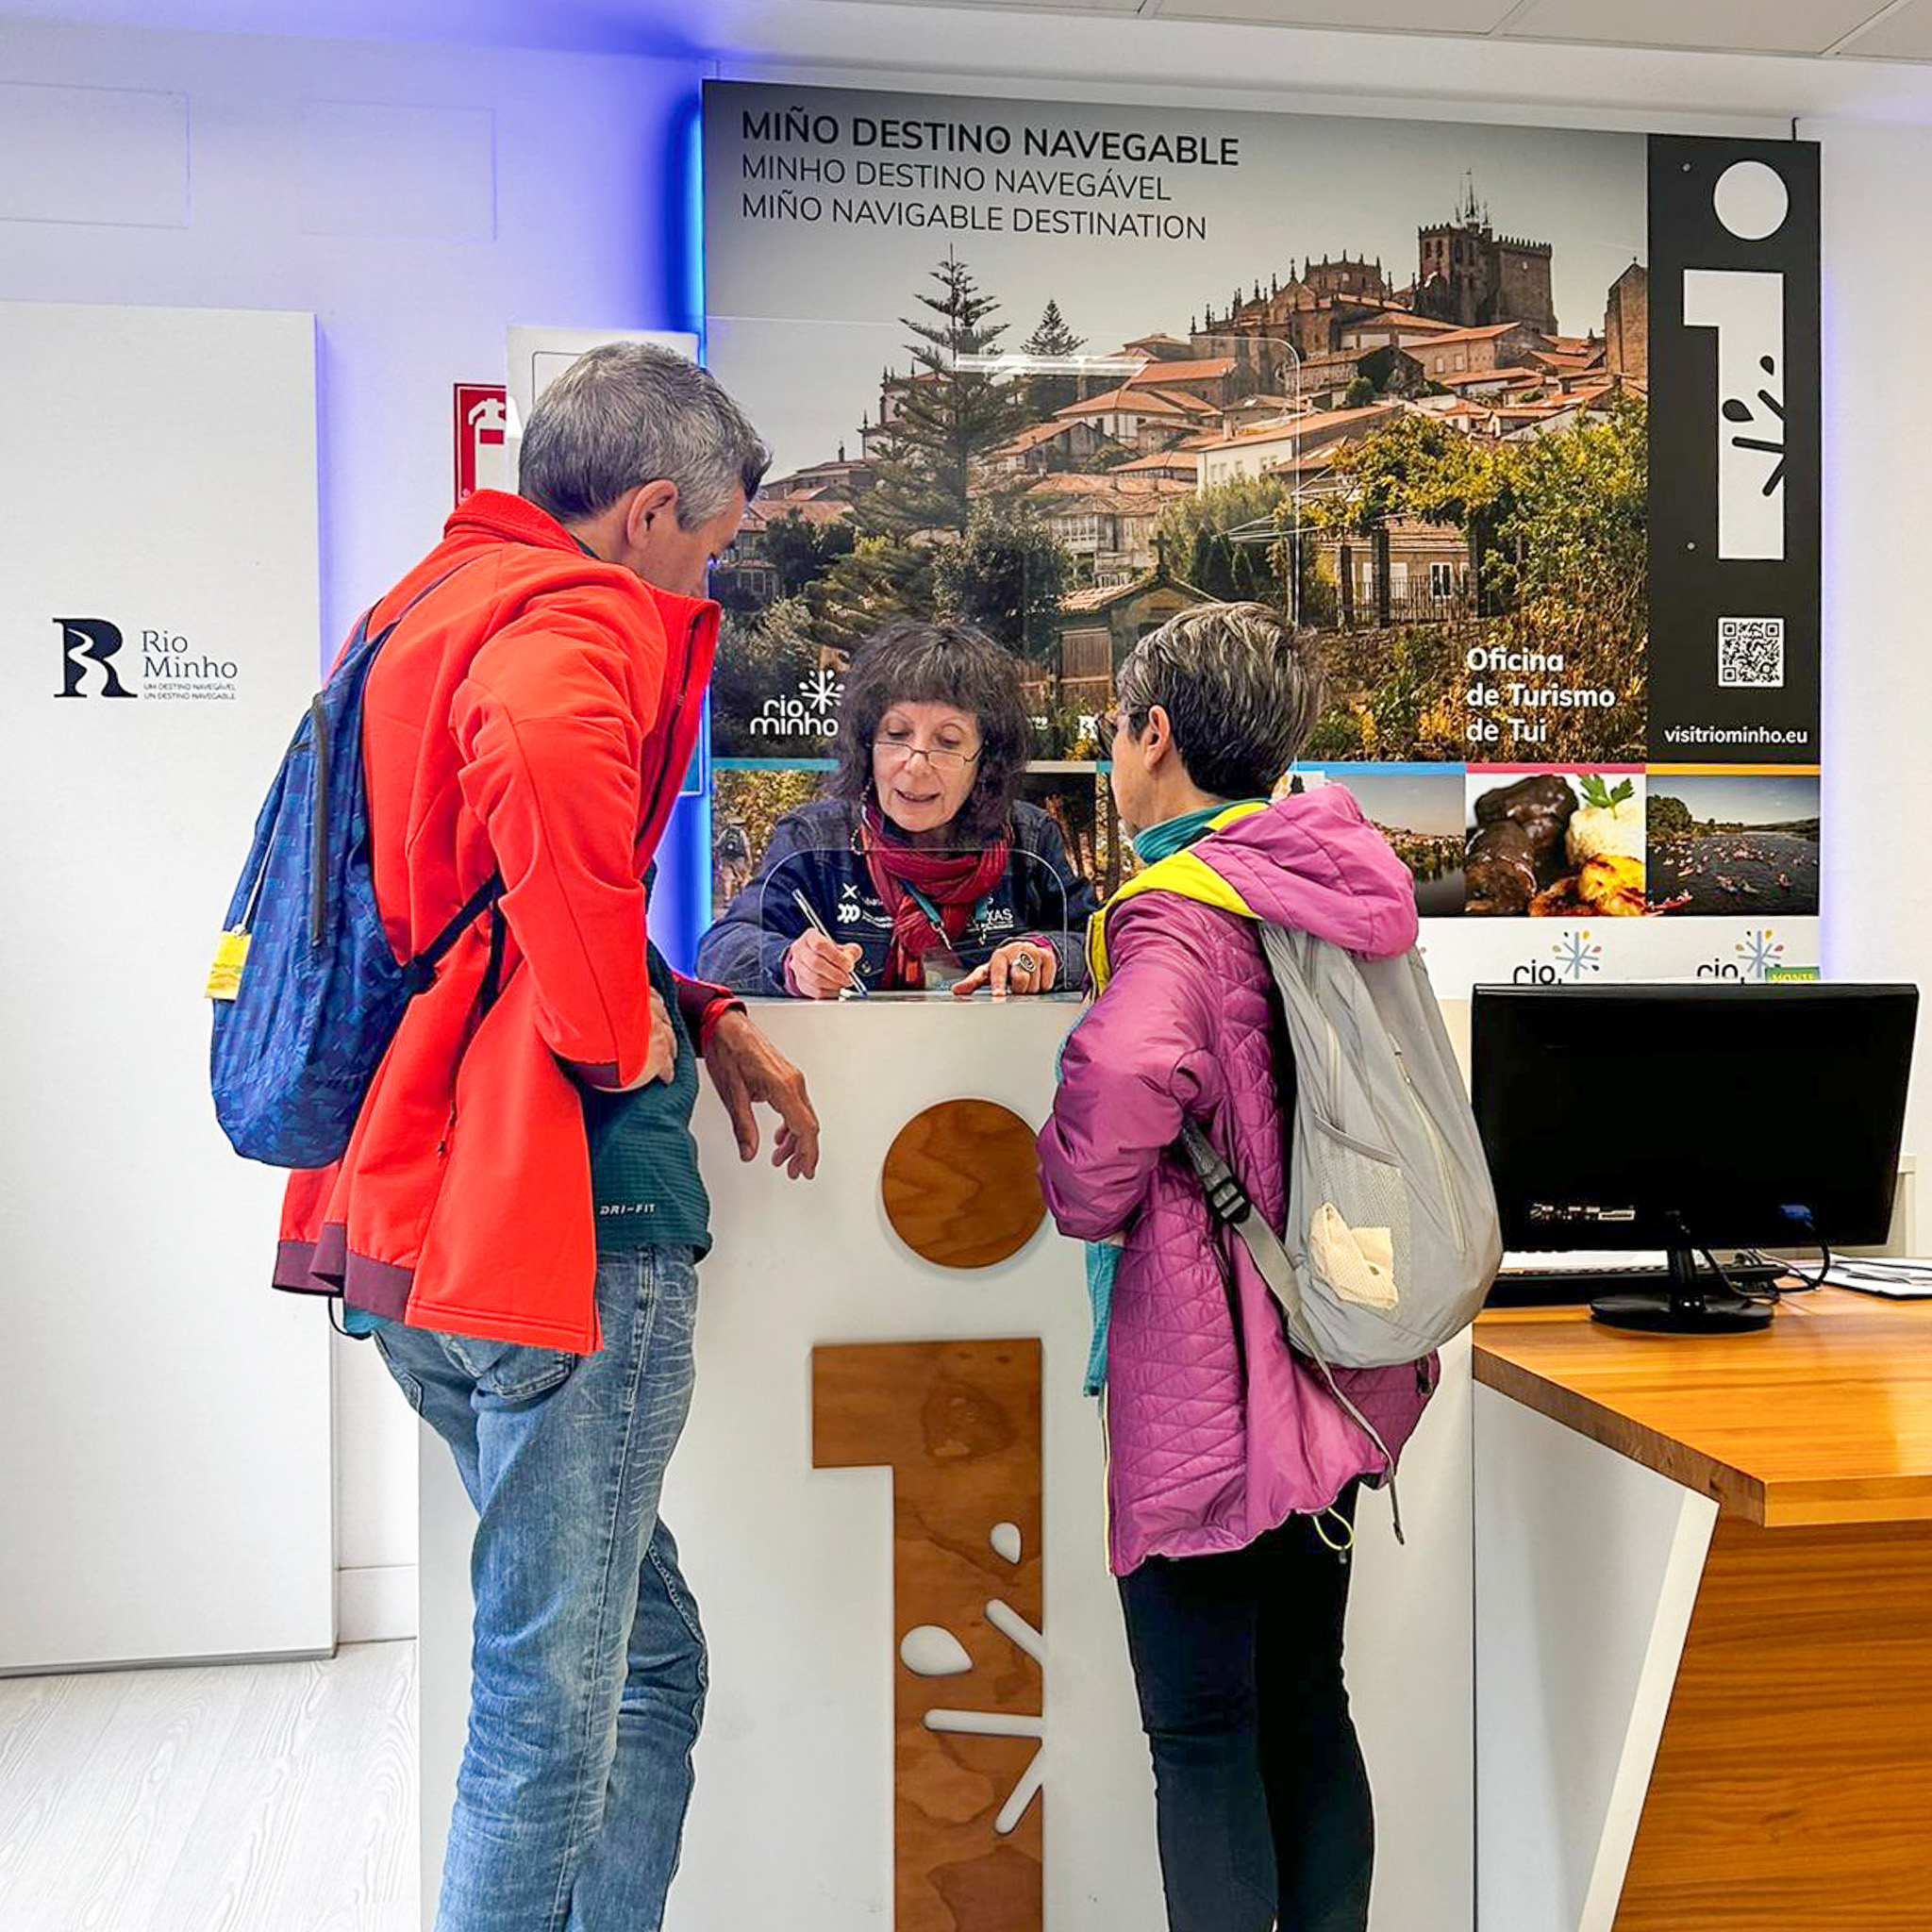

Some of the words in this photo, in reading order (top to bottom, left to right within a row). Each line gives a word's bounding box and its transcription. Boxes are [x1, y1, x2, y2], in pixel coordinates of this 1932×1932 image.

[741, 107, 839, 144] MIÑO
[852, 117, 1011, 155] DESTINO
[1024, 128, 1240, 166] NAVEGABLE
[741, 154, 845, 184] MINHO
[856, 161, 986, 192] DESTINO
[995, 168, 1172, 201] NAVEGÁVEL
[741, 190, 822, 222] MIÑO
[832, 198, 1004, 232] NAVIGABLE
[1012, 208, 1207, 241] DESTINATION
[142, 629, 188, 653] Rio
[142, 656, 238, 679] Minho
[1466, 646, 1565, 673] Oficina
[158, 682, 191, 691] DESTINO
[1466, 682, 1500, 708] de
[1507, 682, 1616, 708] Turismo
[763, 694, 805, 716] rio
[750, 711, 839, 737] minho
[1466, 718, 1500, 743] de
[1664, 725, 1808, 745] visitriominho.eu
[599, 1204, 656, 1216] DRI-FIT
